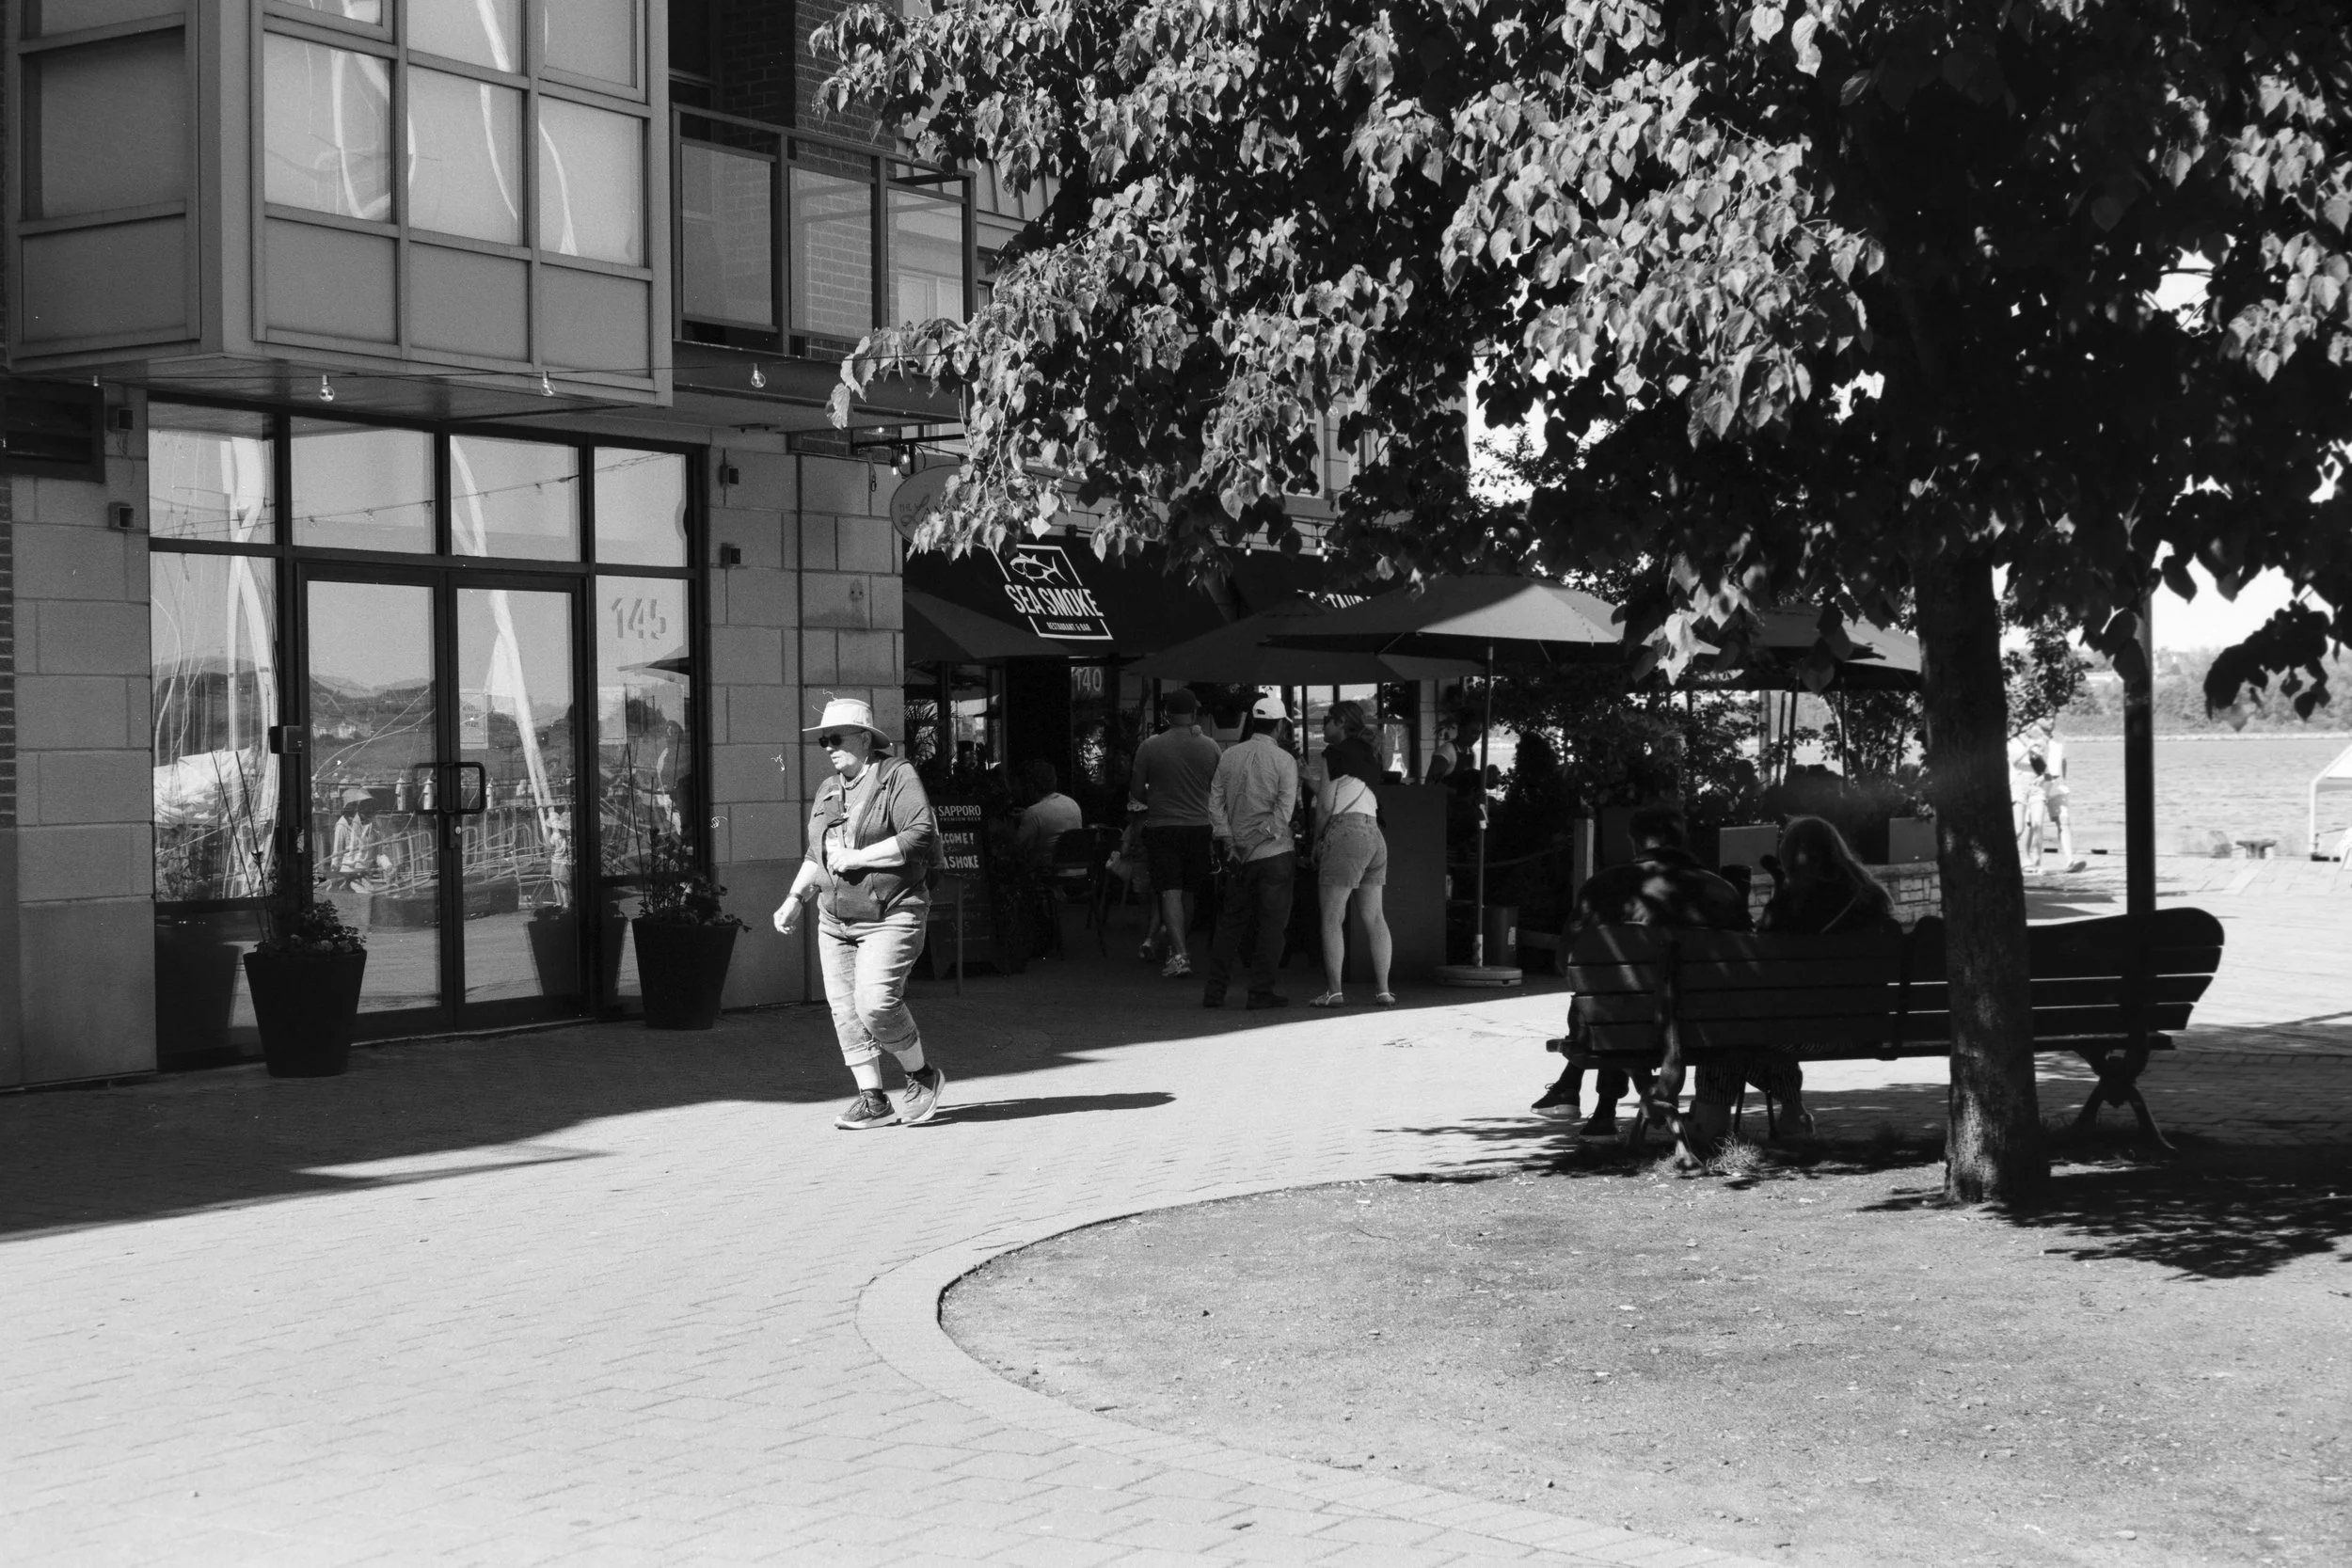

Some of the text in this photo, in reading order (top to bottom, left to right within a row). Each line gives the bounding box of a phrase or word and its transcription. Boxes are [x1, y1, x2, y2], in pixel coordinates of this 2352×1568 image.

[1005, 584, 1104, 617] SEA SMOKE
[612, 597, 667, 641] 145
[1074, 668, 1102, 692] 140
[938, 804, 981, 816] SAPPORO
